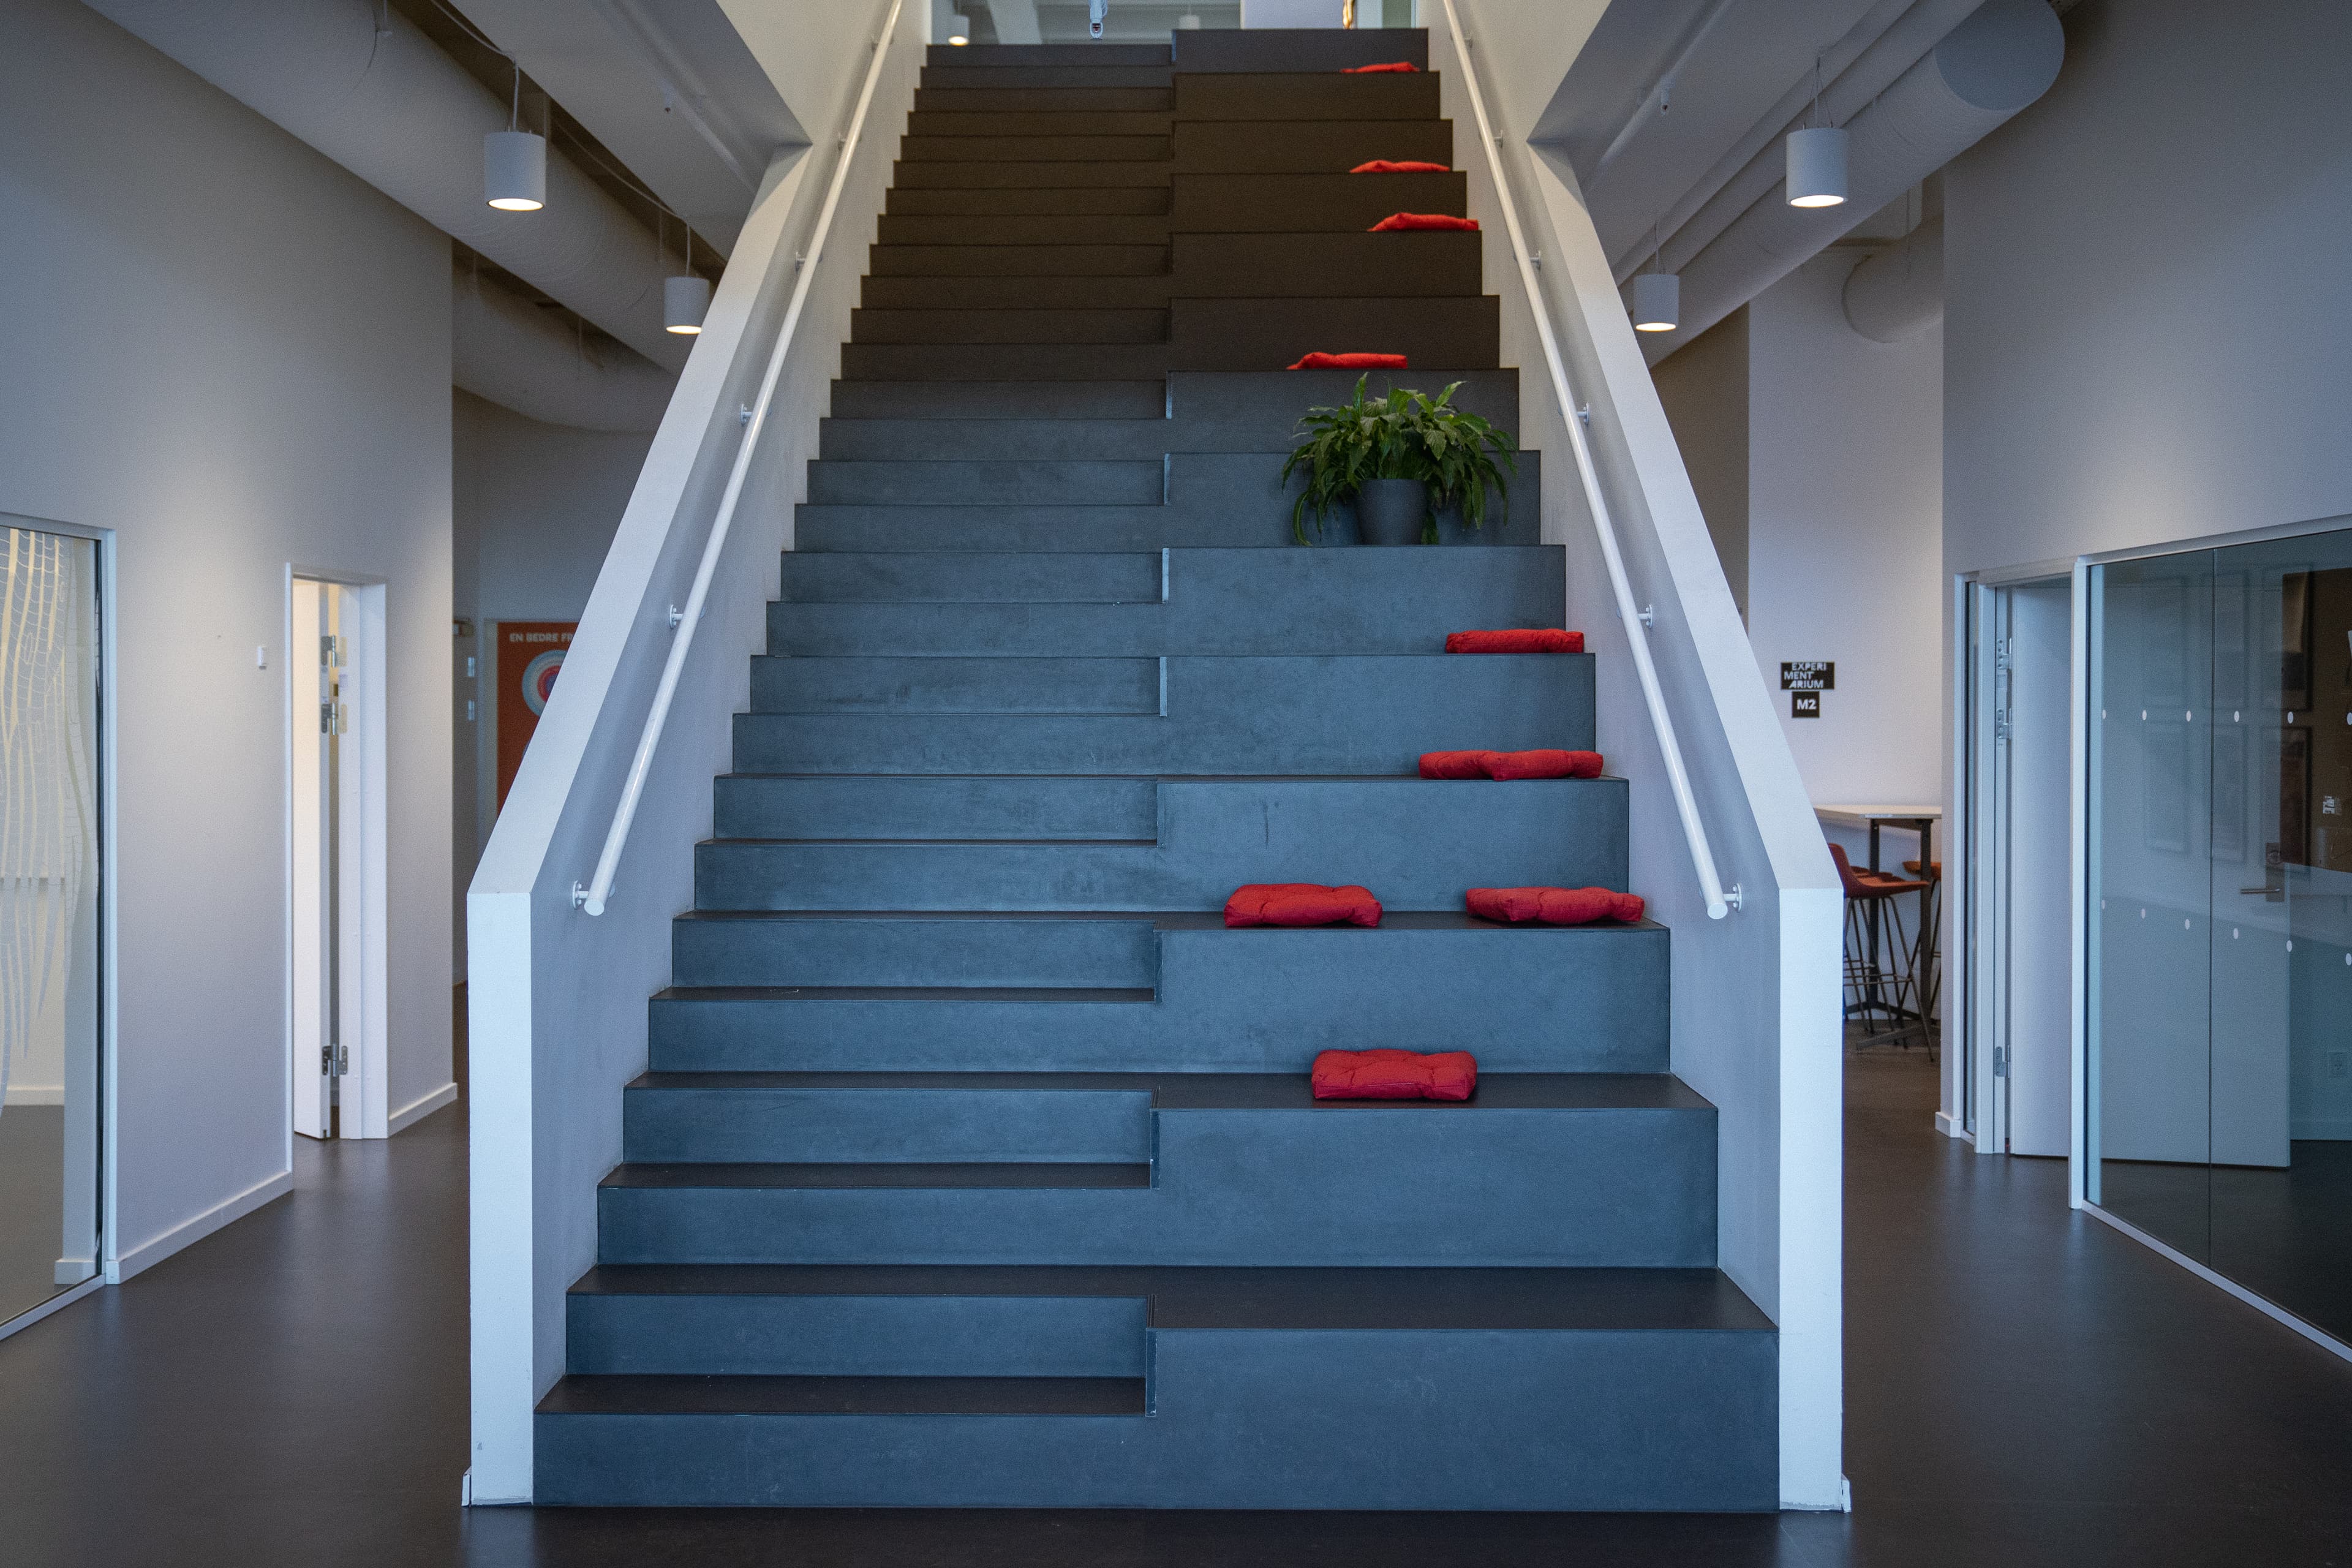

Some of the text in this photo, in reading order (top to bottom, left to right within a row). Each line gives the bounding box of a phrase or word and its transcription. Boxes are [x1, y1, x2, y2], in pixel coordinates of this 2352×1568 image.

[510, 633, 523, 642] EN
[527, 633, 558, 642] BEDRE
[1792, 662, 1826, 671] EXPERI
[1784, 671, 1814, 680] MENT
[1789, 680, 1823, 688] ARIUM
[1796, 699, 1817, 710] M2
